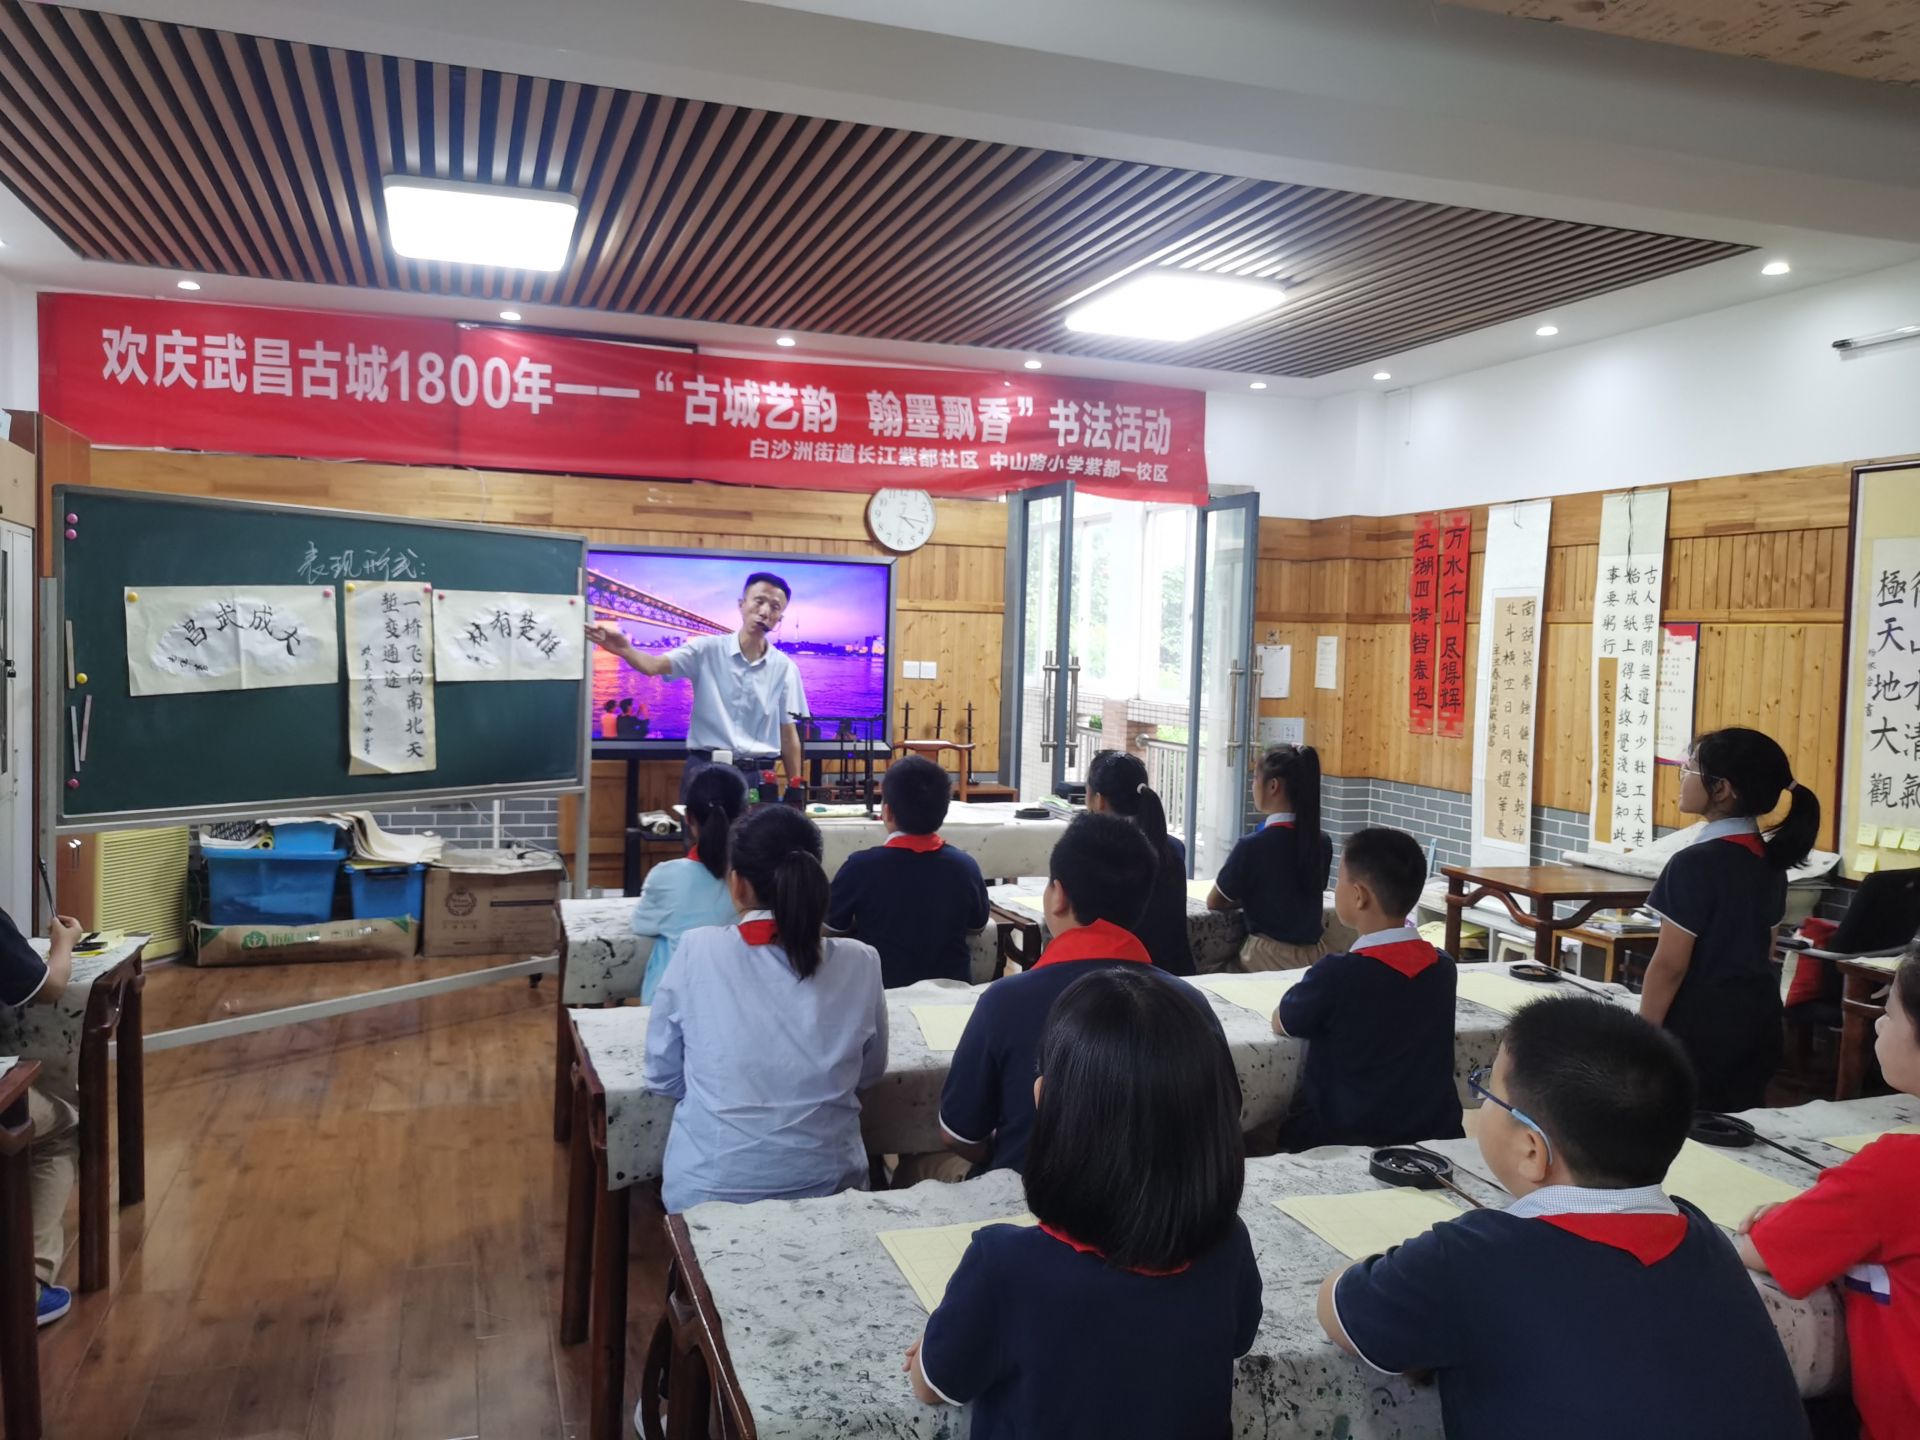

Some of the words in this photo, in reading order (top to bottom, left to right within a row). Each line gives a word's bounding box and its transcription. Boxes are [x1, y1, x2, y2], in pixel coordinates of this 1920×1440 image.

[749, 437, 980, 471] 白沙洲街道长江紫都社区
[989, 452, 1169, 483] 中山路小学紫都一校区
[1411, 532, 1434, 709] 五湖四海皆春色
[1867, 569, 1907, 808] 極天地大觀
